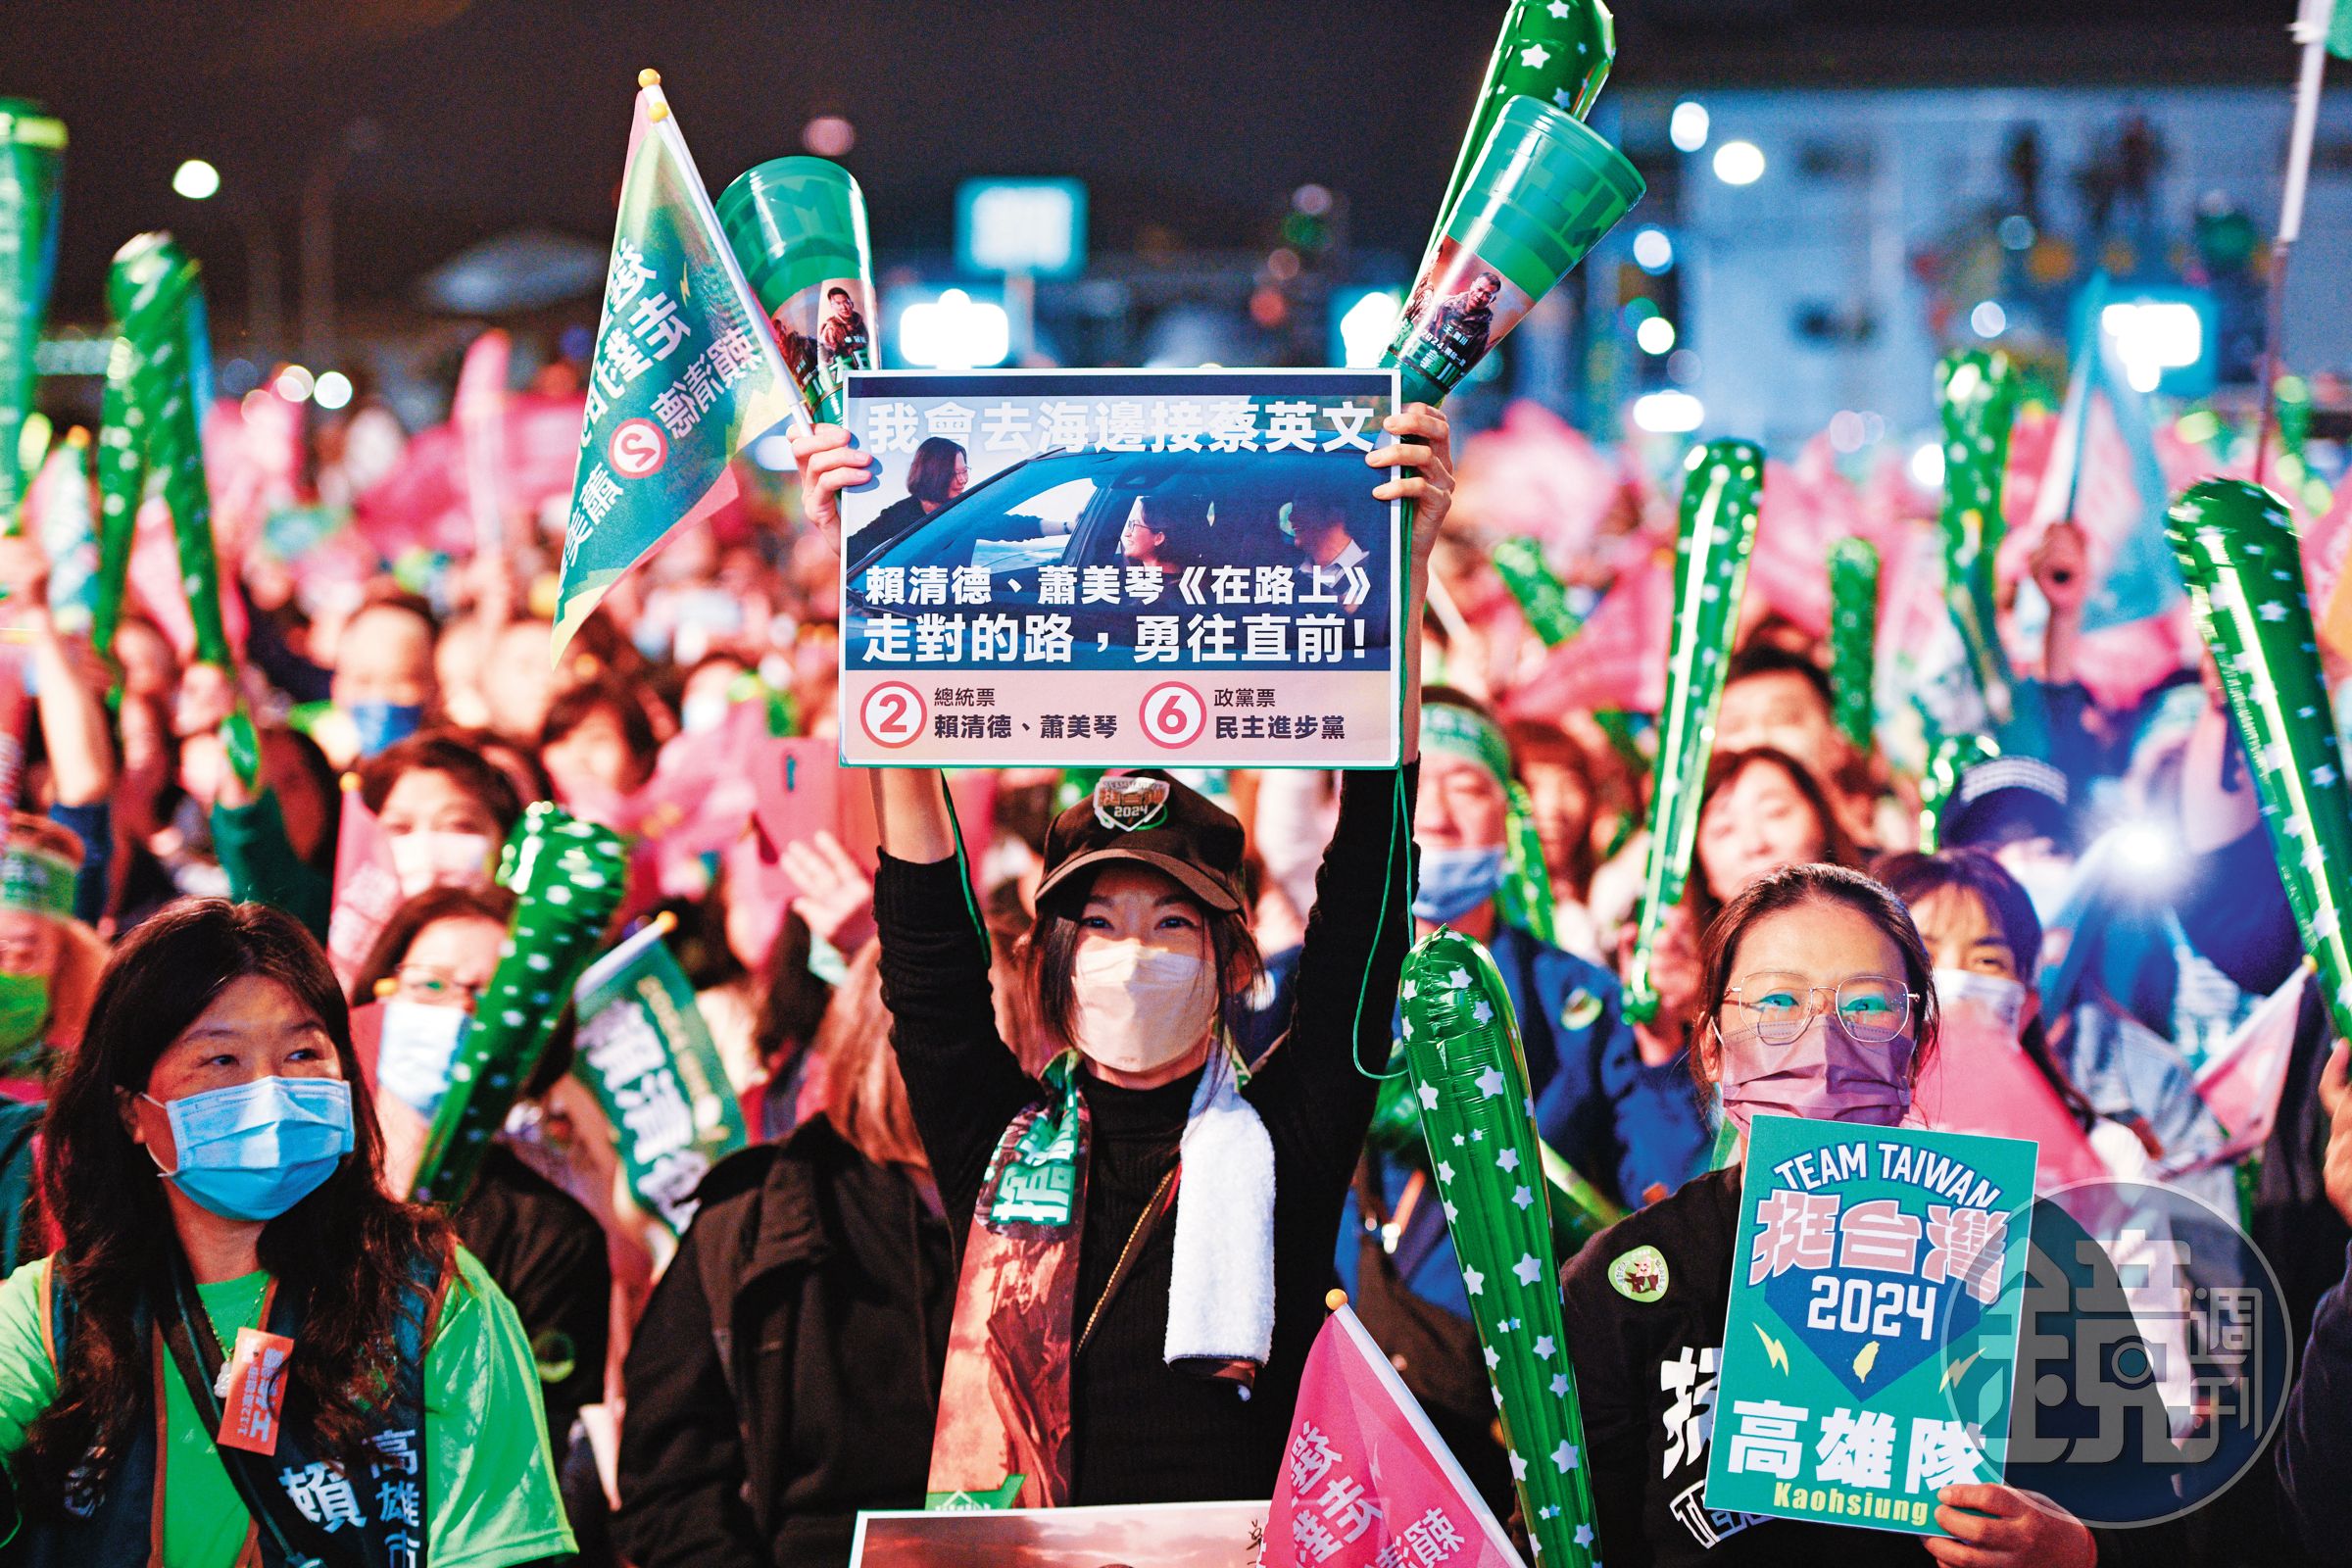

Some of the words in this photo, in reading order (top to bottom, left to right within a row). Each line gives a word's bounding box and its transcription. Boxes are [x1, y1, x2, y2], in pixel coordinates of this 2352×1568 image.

[868, 401, 1374, 454] 我會去海邊接蔡英文
[865, 565, 1371, 606] 賴清德、蕭美琴《在路上》
[879, 694, 907, 733] 2
[934, 688, 996, 707] 總統票
[1156, 695, 1188, 735] 6
[1213, 688, 1276, 708] 政黨票
[934, 714, 1118, 739] 賴清德、蕭美琴
[1215, 715, 1346, 739] 民主進步黨
[1113, 805, 1148, 817] 2024
[1774, 1143, 1866, 1190] TEAM
[1879, 1144, 2001, 1207] TAIWAN
[1749, 1189, 2010, 1303] 挺台灣
[1807, 1275, 1936, 1341] 2024
[1728, 1399, 1986, 1494] 高雄隊
[1773, 1482, 1928, 1526] Kaohsiung
